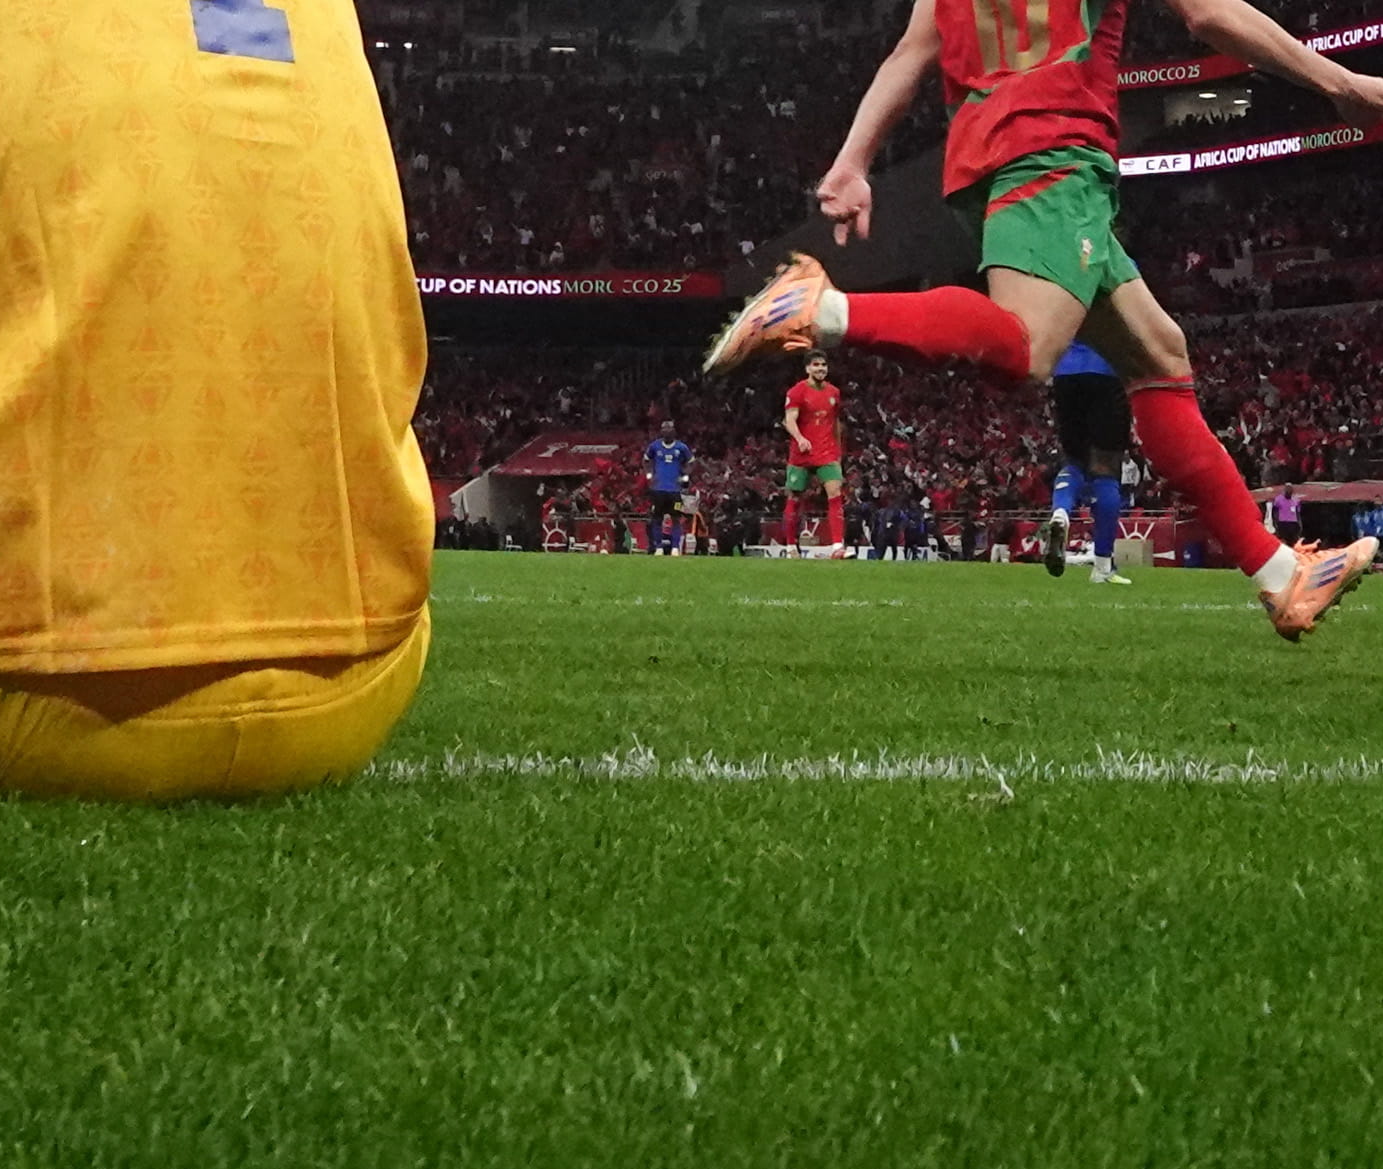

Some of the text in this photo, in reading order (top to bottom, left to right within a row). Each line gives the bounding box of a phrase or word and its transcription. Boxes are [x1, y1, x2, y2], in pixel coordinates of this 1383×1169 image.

[1306, 34, 1342, 52] AFRICA
[1343, 28, 1364, 46] CUP
[1365, 25, 1380, 41] OF
[1118, 64, 1200, 86] MOROCCO 25
[1146, 158, 1182, 171] CAF
[1194, 149, 1227, 169] AFRICA
[1227, 147, 1246, 164] CUP
[1246, 144, 1259, 160] OF
[1259, 136, 1301, 158] NATIONS
[1301, 129, 1351, 149] MOROCCO
[449, 278, 476, 294] OF
[479, 279, 561, 295] NATIONS
[662, 278, 682, 293] 25
